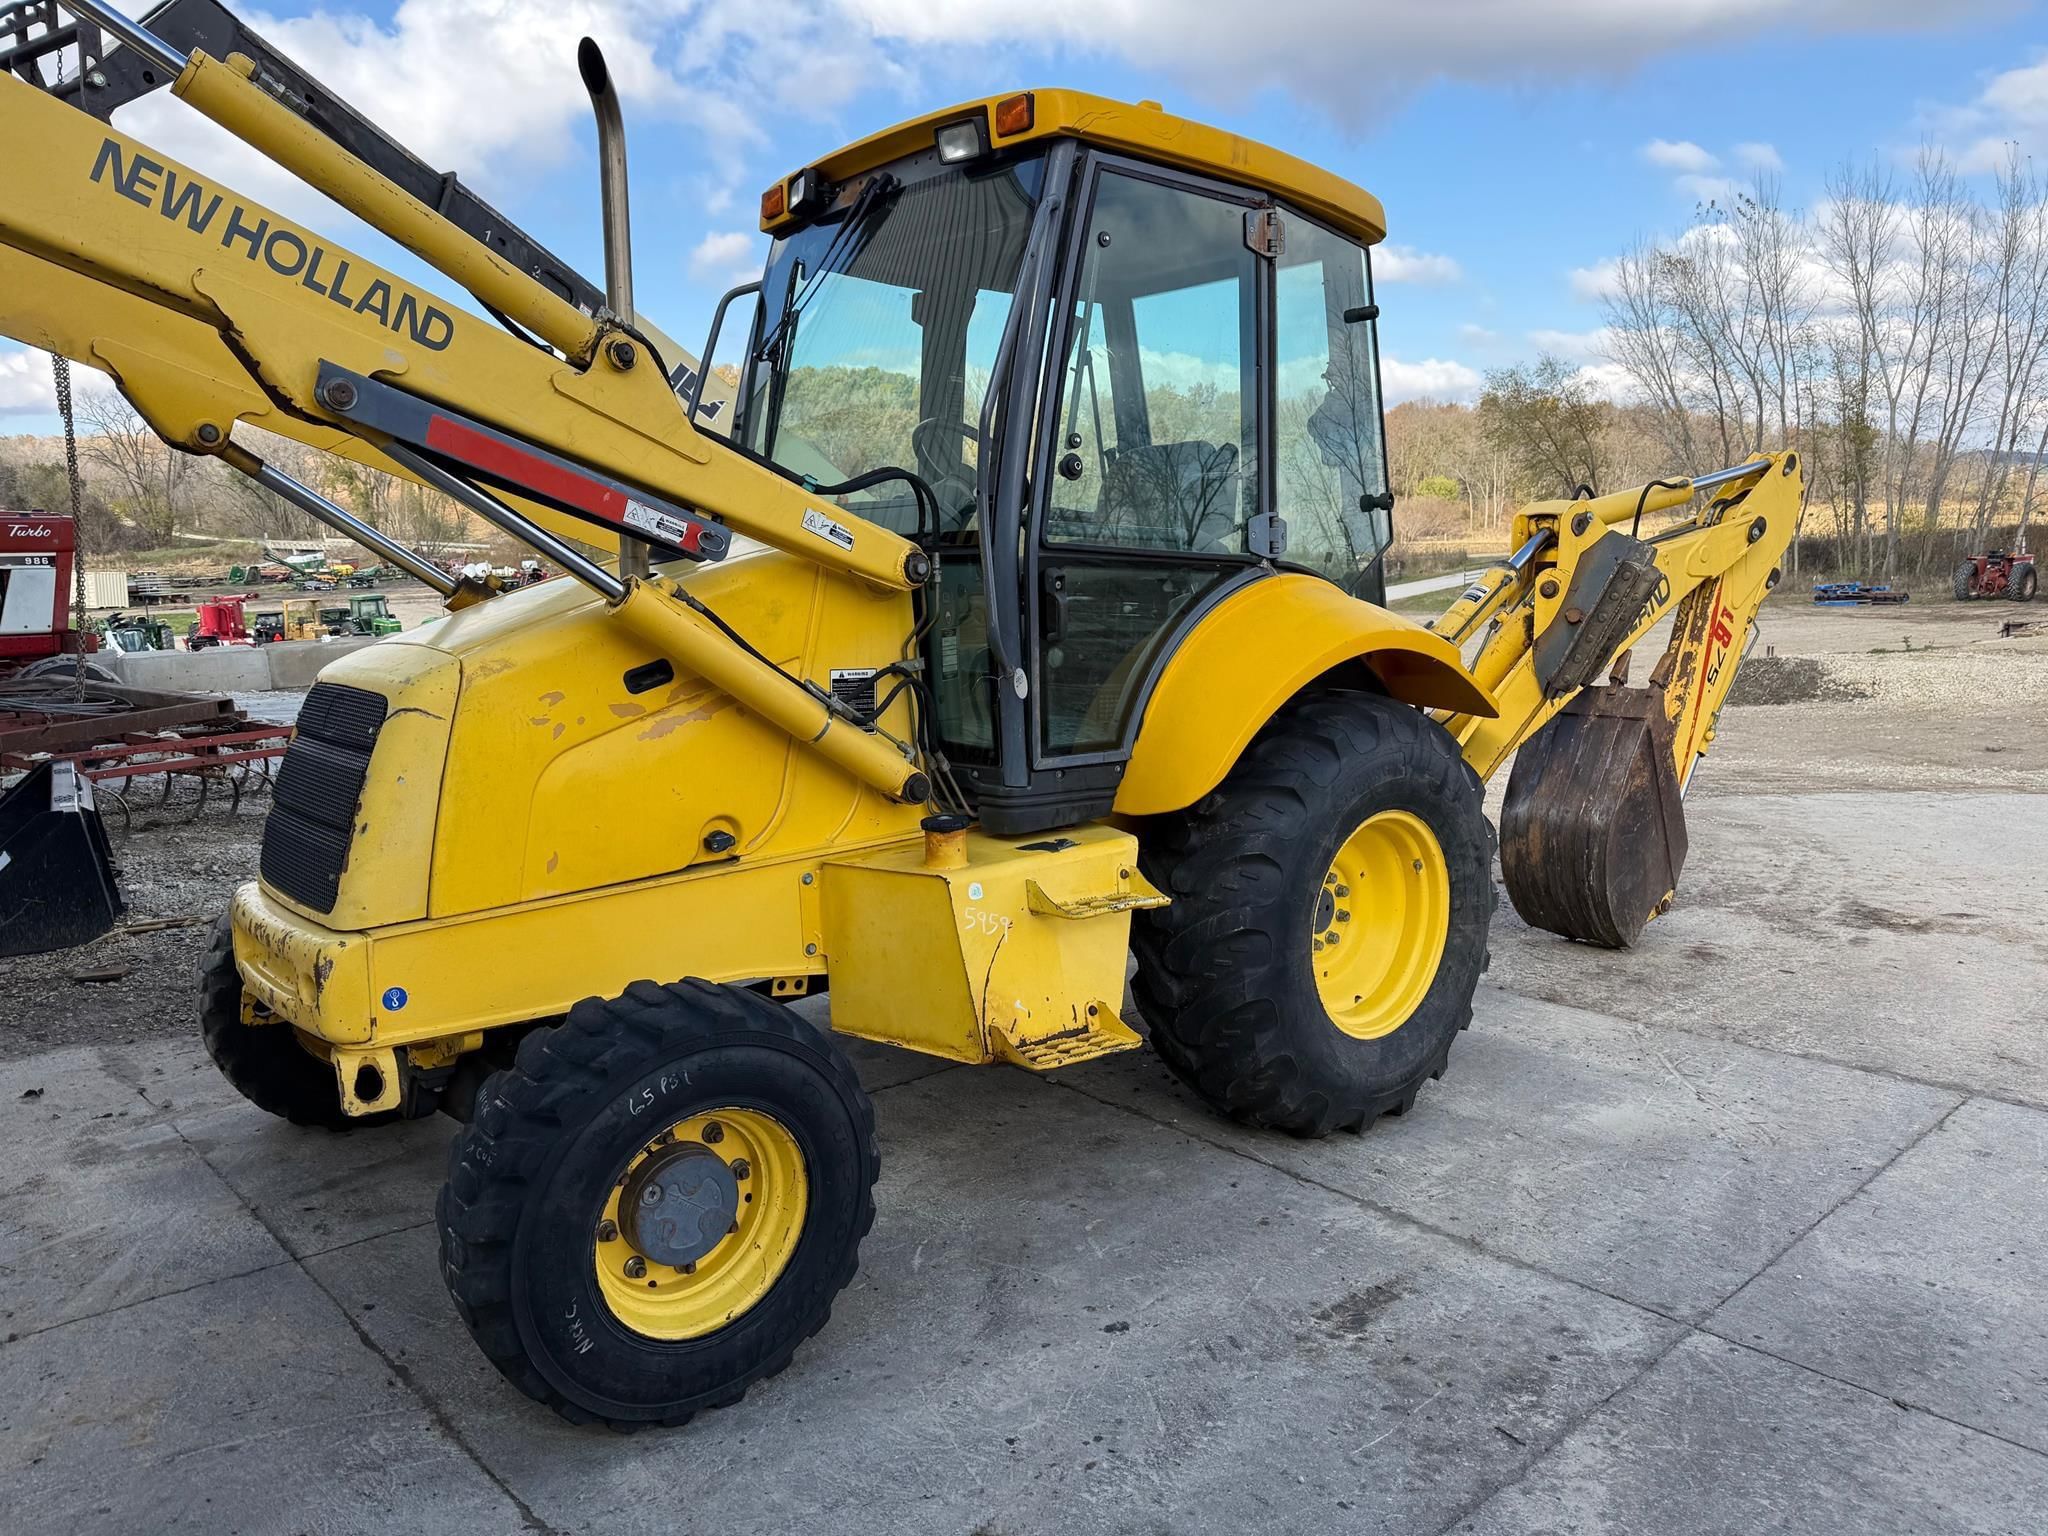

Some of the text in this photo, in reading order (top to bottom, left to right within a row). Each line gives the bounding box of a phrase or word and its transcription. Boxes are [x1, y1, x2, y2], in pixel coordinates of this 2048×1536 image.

[90, 138, 454, 351] NEW HOLLAND
[8, 524, 51, 537] Turbo
[25, 557, 49, 565] 986
[964, 906, 1009, 944] 5959
[629, 1087, 655, 1116] 65
